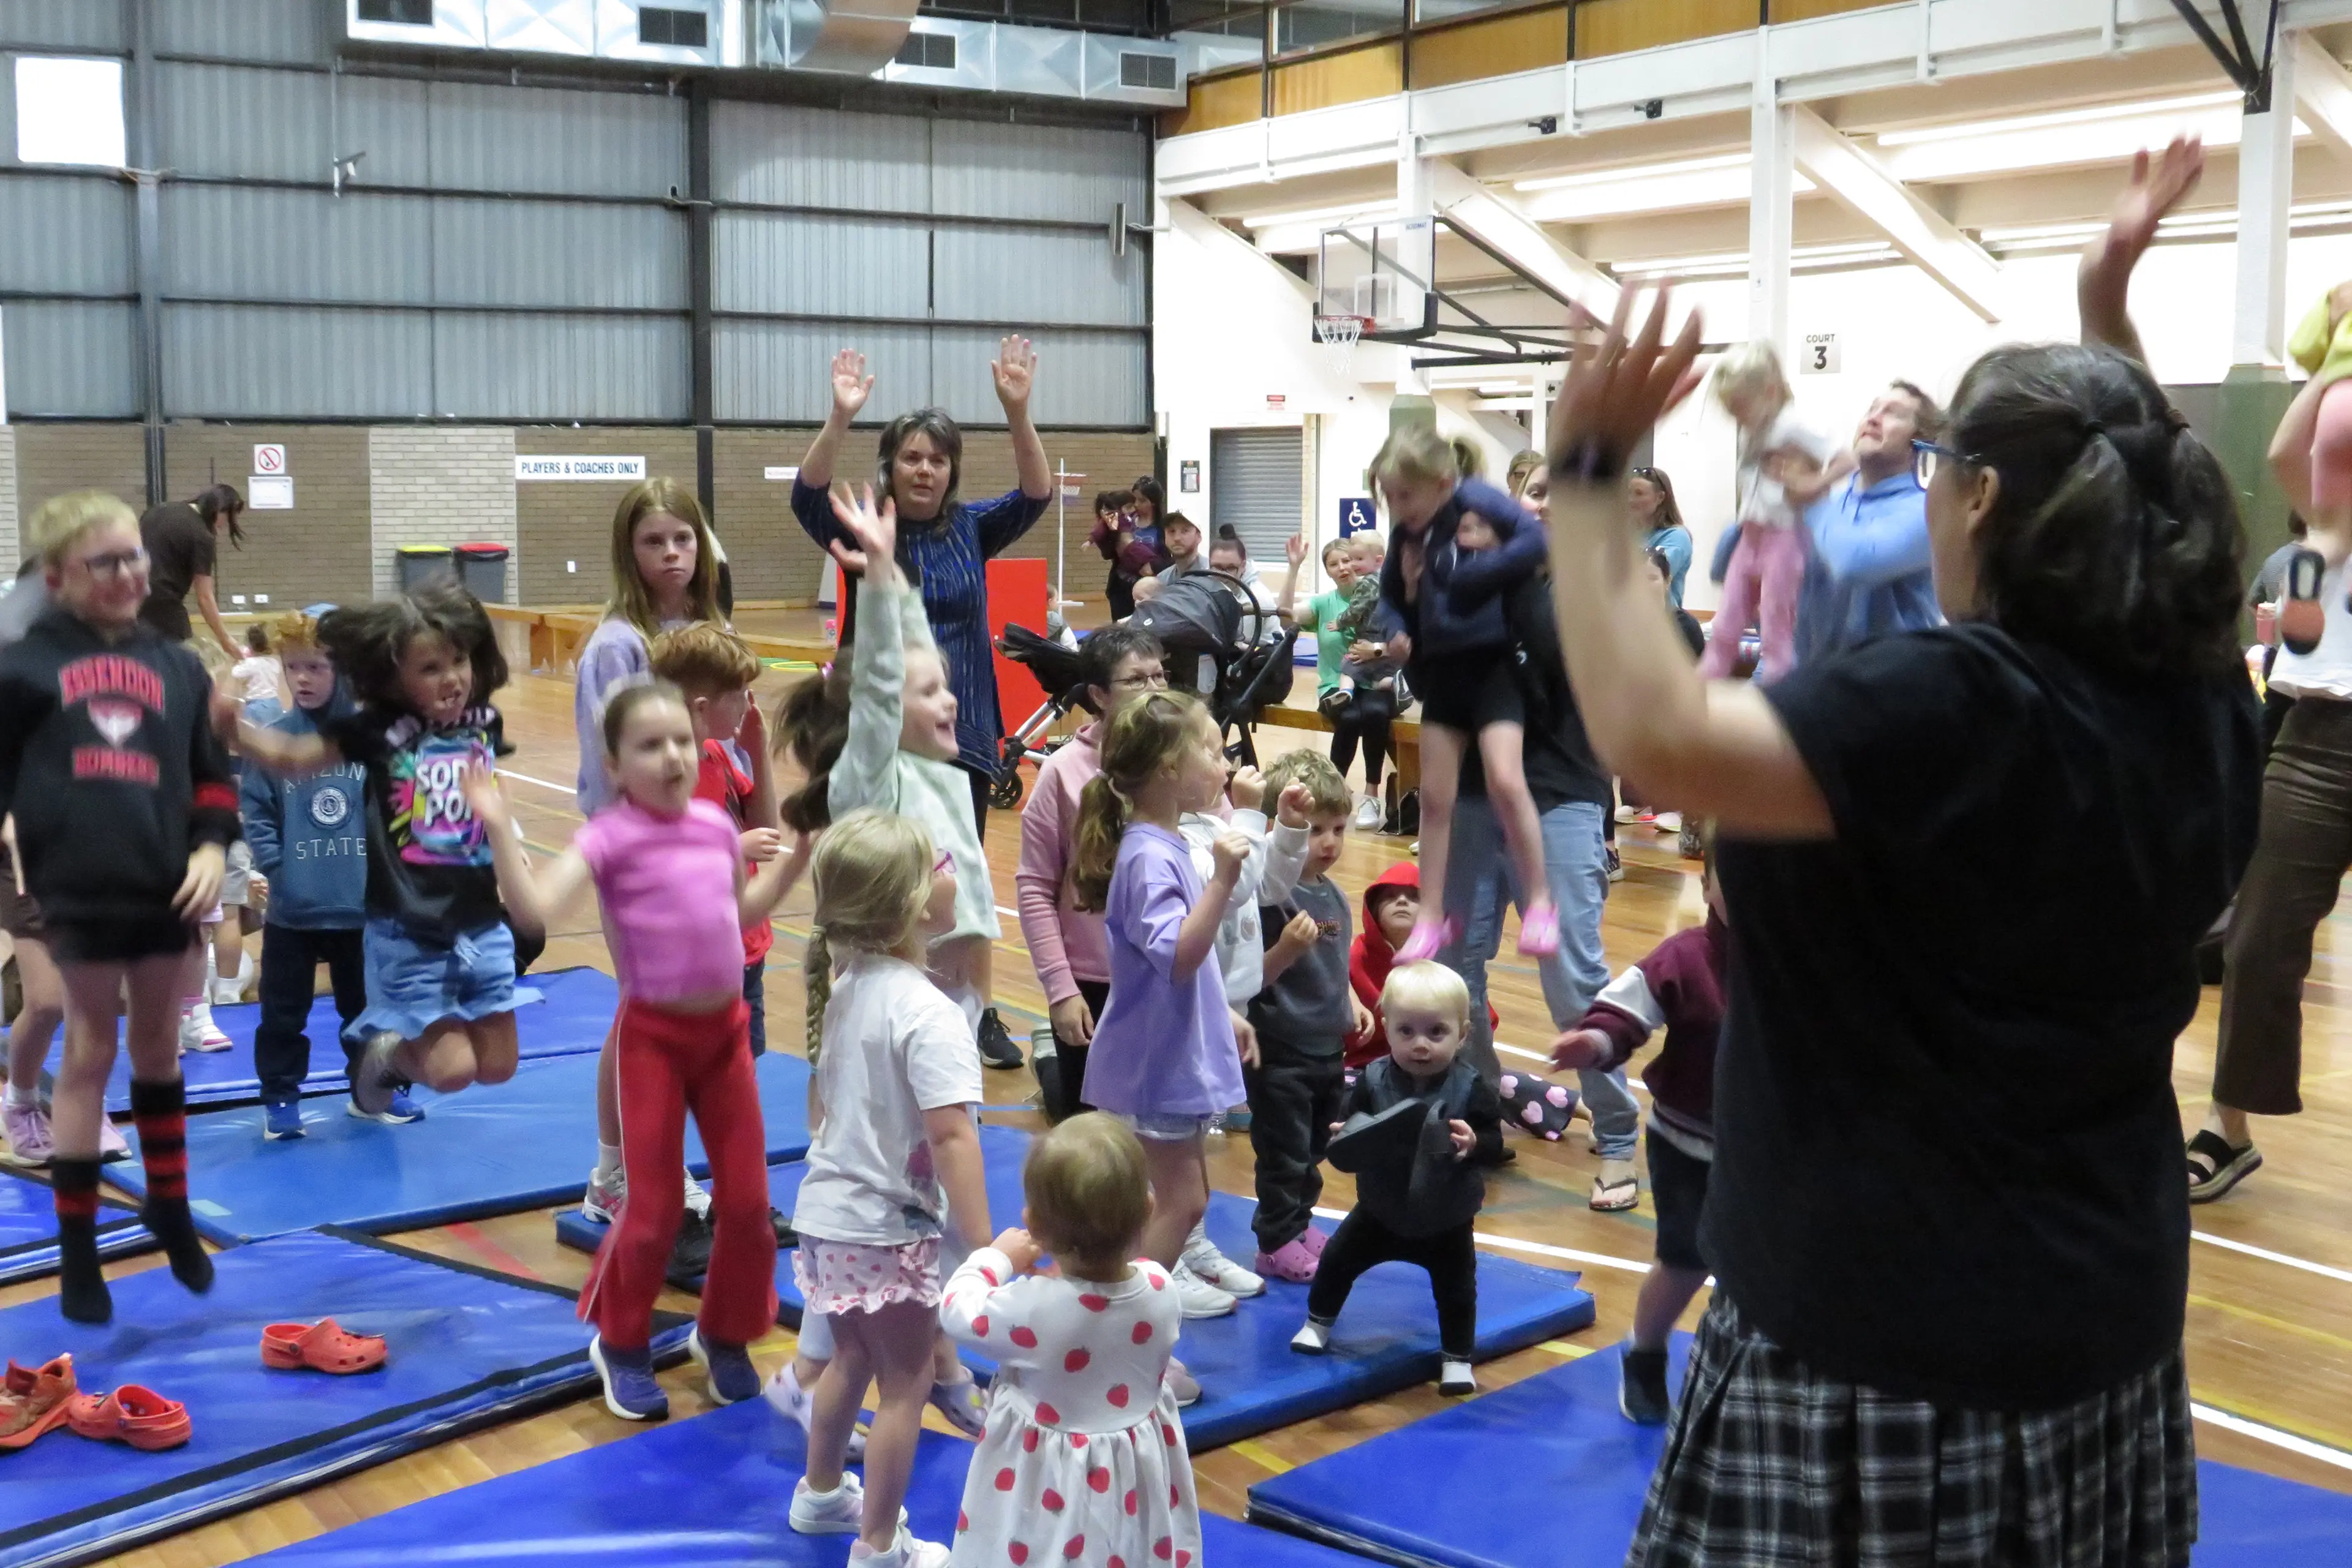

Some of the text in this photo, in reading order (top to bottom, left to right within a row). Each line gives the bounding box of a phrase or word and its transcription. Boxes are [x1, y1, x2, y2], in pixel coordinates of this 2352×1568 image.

[1806, 333, 1836, 343] COURT
[1814, 345, 1827, 370] 3
[521, 462, 639, 473] PLAYERS & COACHES ONLY
[296, 837, 368, 860] STATE
